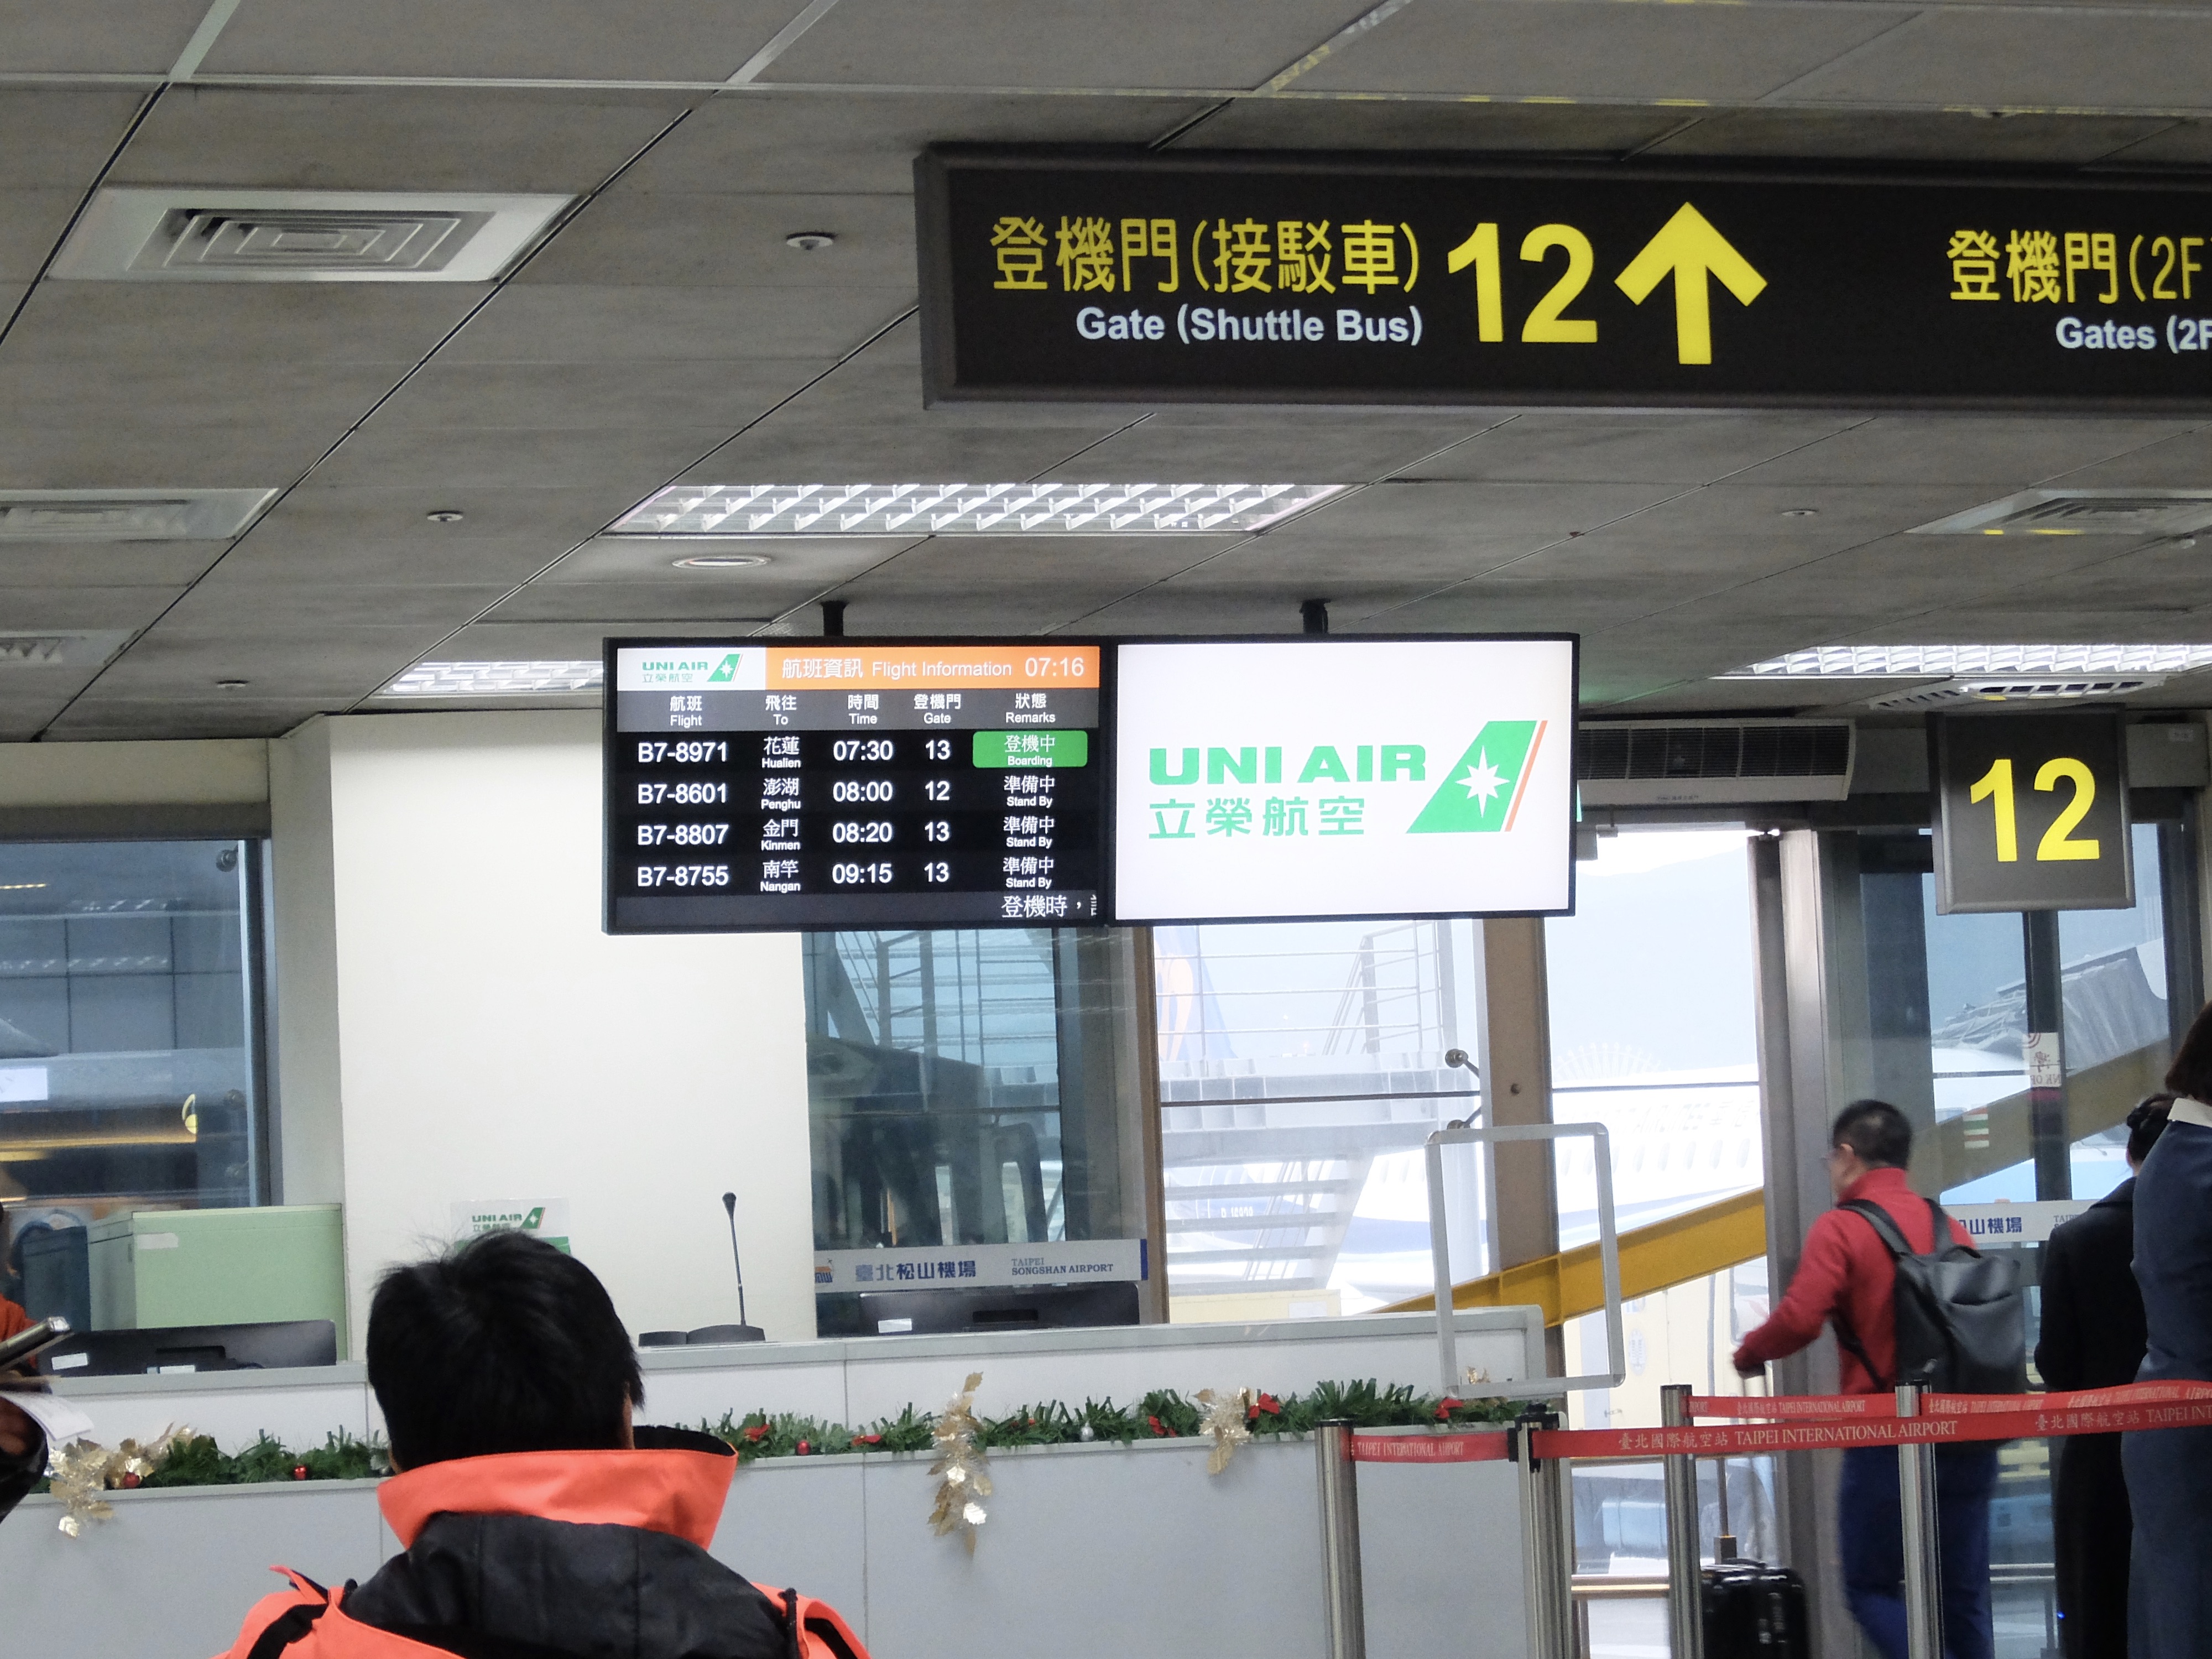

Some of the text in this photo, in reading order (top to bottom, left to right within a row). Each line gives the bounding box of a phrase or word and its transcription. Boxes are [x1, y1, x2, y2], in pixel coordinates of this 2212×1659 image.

[990, 216, 1418, 294] 登機門(接駁車)
[1946, 229, 2212, 304] 登機門(2F
[1448, 223, 1597, 342] 12
[1077, 304, 1422, 346] Gate (Shuttle Bus)
[2056, 317, 2156, 349] Gates
[643, 662, 708, 670] UNI AIR
[782, 657, 1084, 680] 航班資訊 Flight Information 07:16
[643, 674, 692, 682] 立榮航空
[670, 696, 702, 711] 航班
[765, 695, 797, 711] 飛往
[848, 694, 879, 710] 時間
[914, 693, 961, 709] 登機門
[1015, 693, 1046, 709] 狀態
[670, 714, 702, 728] Flight
[773, 714, 788, 725] To
[849, 713, 877, 724] Time
[924, 712, 951, 724] Gate
[1006, 712, 1055, 723] Remarks
[639, 742, 727, 762] B7-8971
[764, 736, 800, 755] 花蓮
[833, 740, 893, 760] 07:30
[926, 740, 951, 760] 13
[1004, 734, 1055, 753] 登機中
[762, 758, 801, 768] Hualien
[1008, 755, 1052, 767] Boarding
[1150, 745, 1426, 785] UNI AIR
[638, 783, 726, 804] B7-8601
[763, 778, 799, 796] 澎湖
[833, 781, 893, 802] 08:00
[925, 781, 950, 800] 12
[1004, 775, 1055, 794] 準備中
[761, 799, 801, 811] Penghu
[1007, 796, 1052, 808] Stand By
[1970, 758, 2100, 862] 12
[1004, 816, 1054, 834] 準備中
[1149, 796, 1364, 839] 立榮航空
[638, 824, 729, 845] B7-8807
[763, 819, 799, 837] 金門
[833, 822, 893, 843] 08:20
[925, 821, 950, 841] 13
[761, 840, 800, 851] Kinmen
[1006, 837, 1052, 848] Stand By
[763, 860, 799, 878] 南竿
[832, 863, 892, 884] 09:15
[925, 862, 949, 882] 13
[1003, 856, 1053, 875] 準備中
[638, 865, 729, 886] B7-8755
[1006, 877, 1052, 889] Stand By
[760, 881, 801, 893] Nangan
[1958, 1217, 2022, 1235] 山機場
[855, 1261, 975, 1281] 臺北松山機場
[1011, 1258, 1045, 1266] TAIPEI
[1011, 1264, 1114, 1276] SONGSHAN AIRPORT
[2034, 1411, 2140, 1432] 臺北國際航空站
[2145, 1406, 2188, 1423] TAIPEI
[1618, 1432, 1729, 1450] 臺北國際航空站
[1734, 1420, 1958, 1446] TAIPEI INTERNATIONAL AIRPORT
